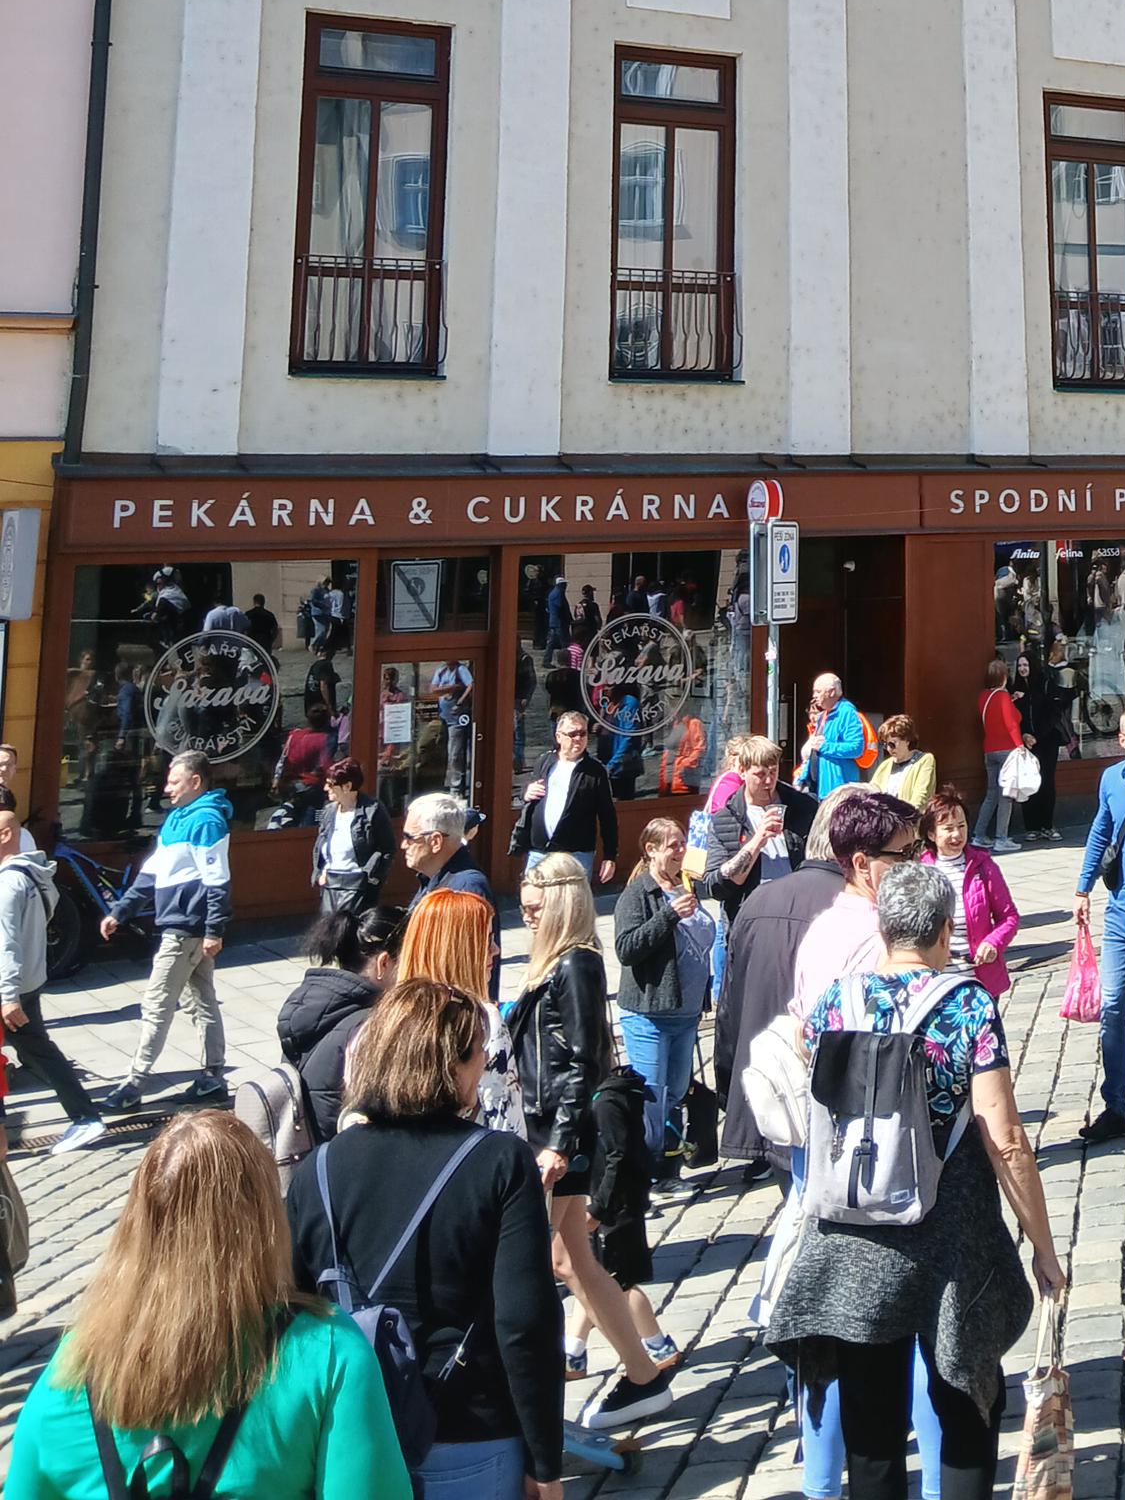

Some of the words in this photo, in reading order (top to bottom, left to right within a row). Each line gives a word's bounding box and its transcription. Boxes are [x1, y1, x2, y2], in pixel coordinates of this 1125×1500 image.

[112, 491, 376, 528] PEKÁRNA
[408, 497, 433, 525] &
[466, 488, 731, 522] CUKRÁRNA
[949, 483, 1093, 514] SPODNÍ
[1009, 548, 1041, 559] Anita
[1055, 548, 1084, 559] felina
[1097, 548, 1120, 557] sassa
[600, 622, 677, 652] PEKAŘST
[588, 651, 685, 687] Sázava
